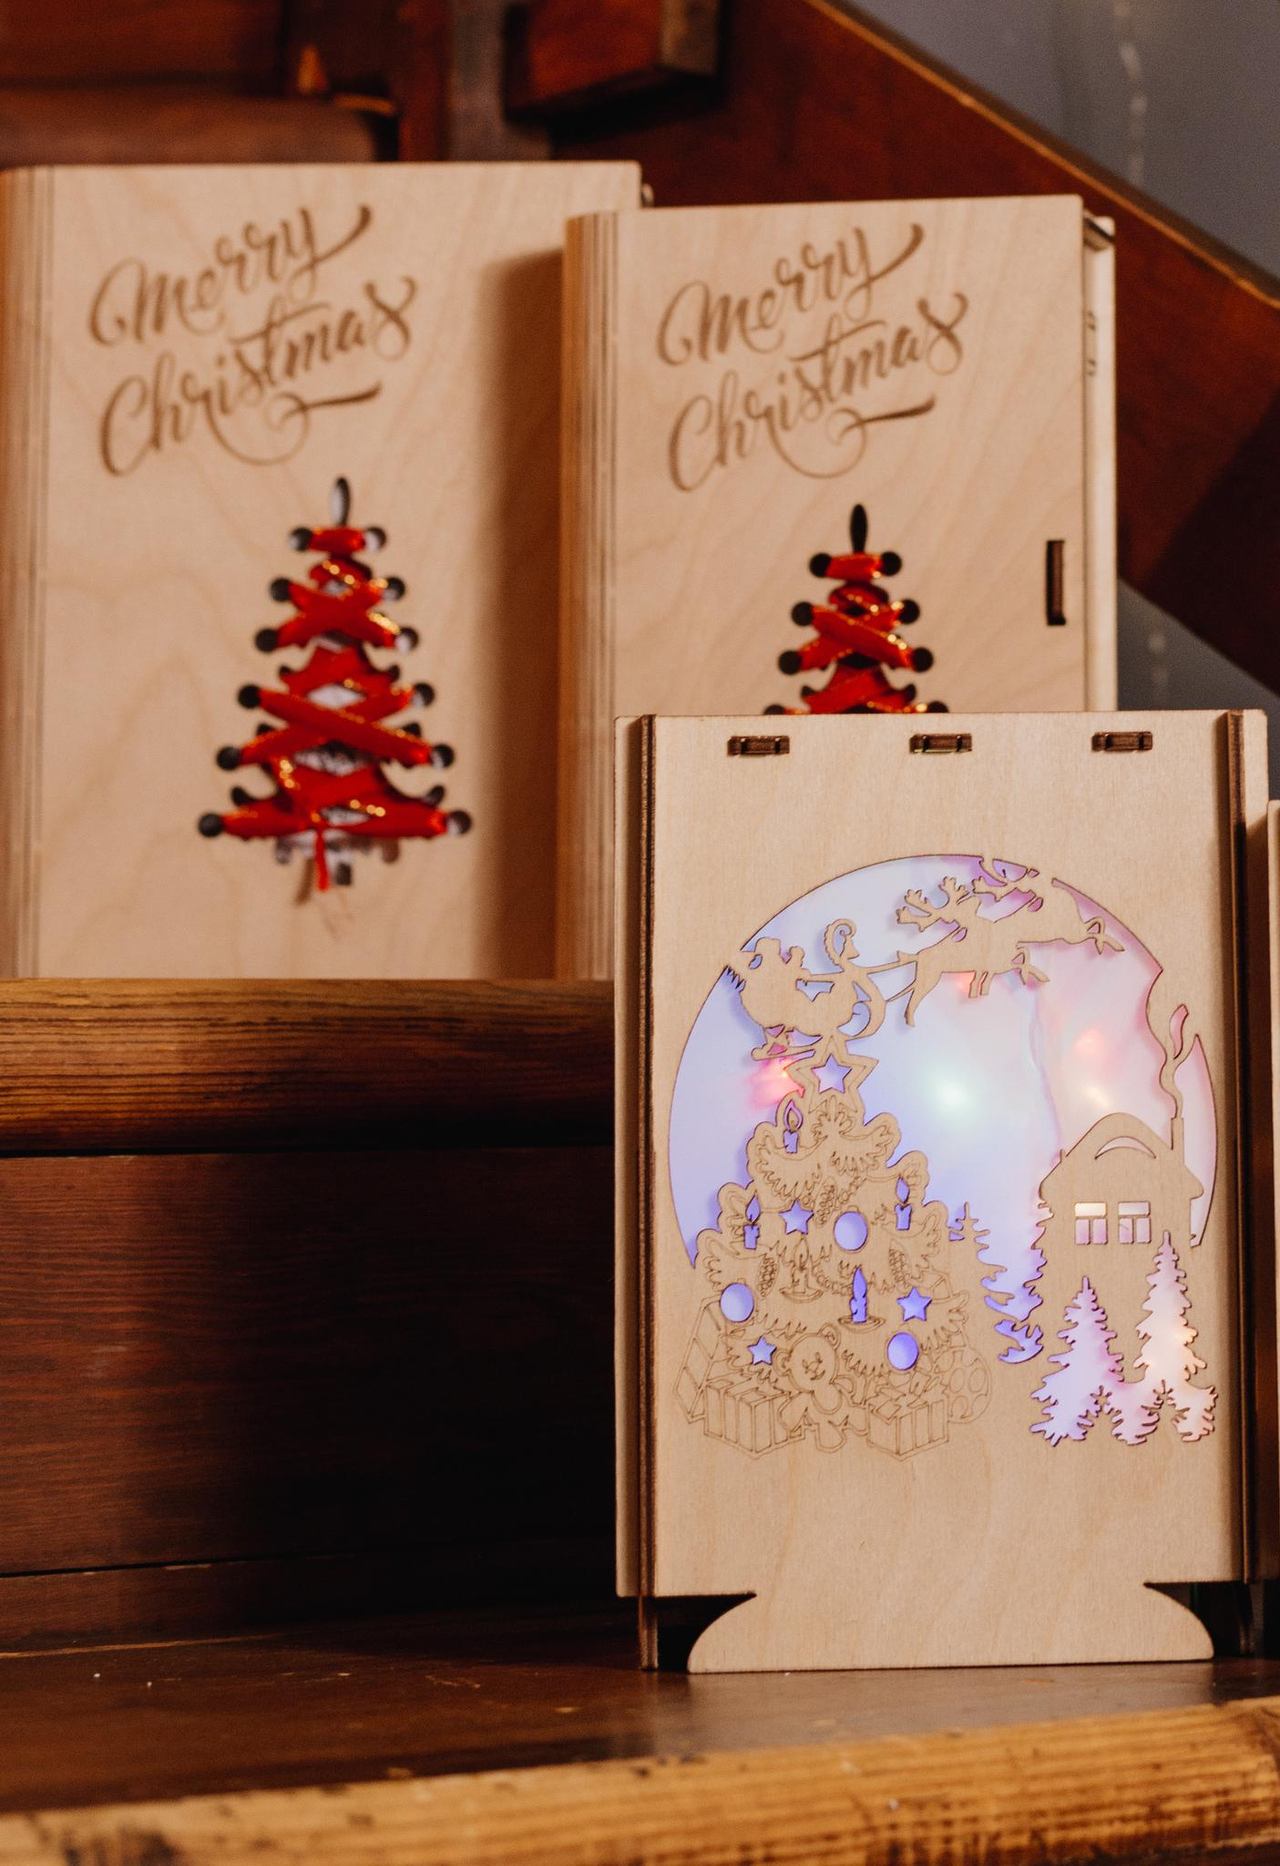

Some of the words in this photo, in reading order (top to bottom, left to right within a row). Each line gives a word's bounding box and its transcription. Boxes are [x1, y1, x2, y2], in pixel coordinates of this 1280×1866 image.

[89, 204, 372, 346] Merry
[656, 222, 924, 367] Merry
[100, 276, 417, 476] Christmas
[668, 292, 969, 492] Christmas
